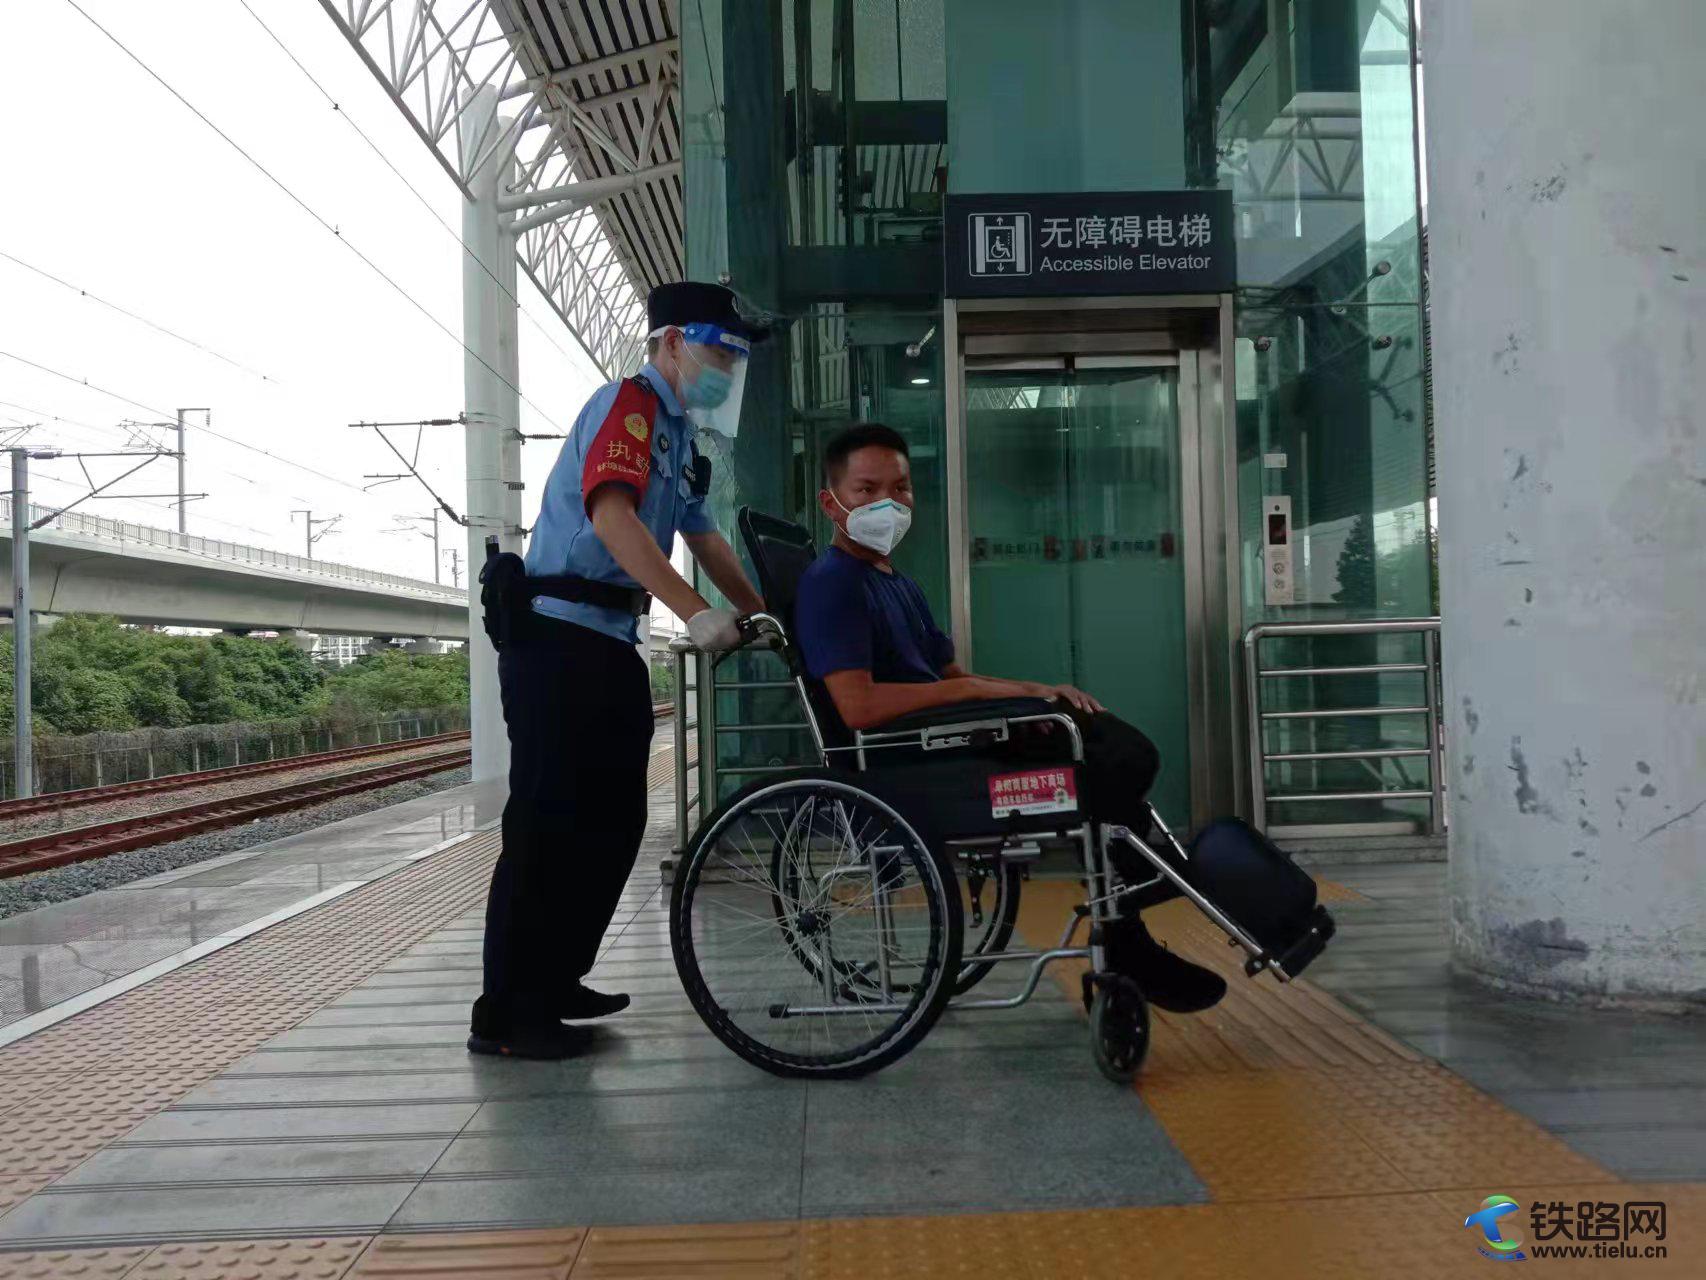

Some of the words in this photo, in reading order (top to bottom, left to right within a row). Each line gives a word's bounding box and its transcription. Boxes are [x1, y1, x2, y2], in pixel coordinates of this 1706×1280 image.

[1039, 213, 1212, 249] 无障碍电梯
[1039, 256, 1134, 273] Accessible
[1139, 254, 1212, 271] Elevator
